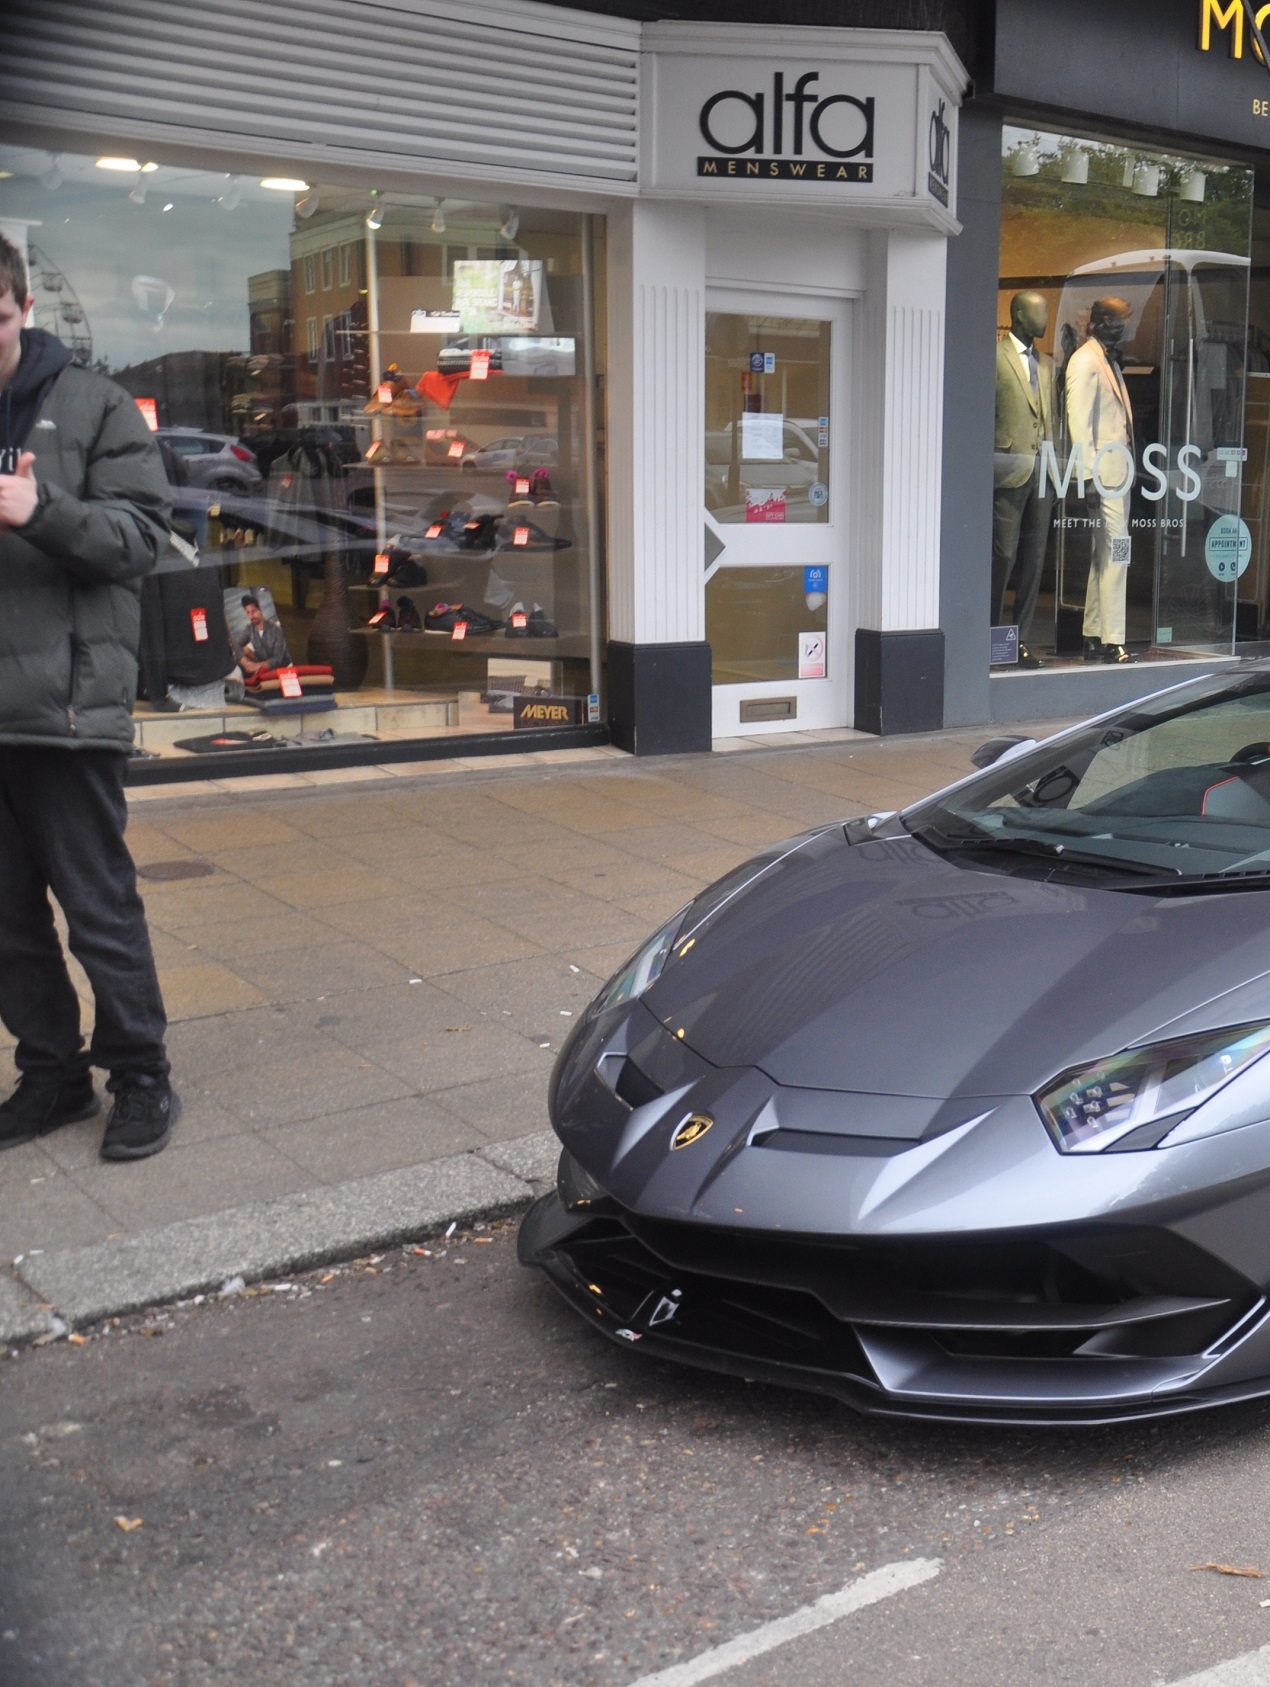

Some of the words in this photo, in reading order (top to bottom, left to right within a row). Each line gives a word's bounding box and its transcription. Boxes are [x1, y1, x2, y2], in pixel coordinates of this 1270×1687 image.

[699, 71, 876, 158] alfa
[703, 160, 869, 180] MENSWEAR
[1038, 440, 1201, 501] MOSS
[1053, 518, 1078, 528] MEET
[1082, 518, 1101, 528] THE
[1131, 518, 1157, 528] MOSS
[1211, 540, 1246, 549] APPOINTMNT
[520, 703, 569, 720] MEYER
